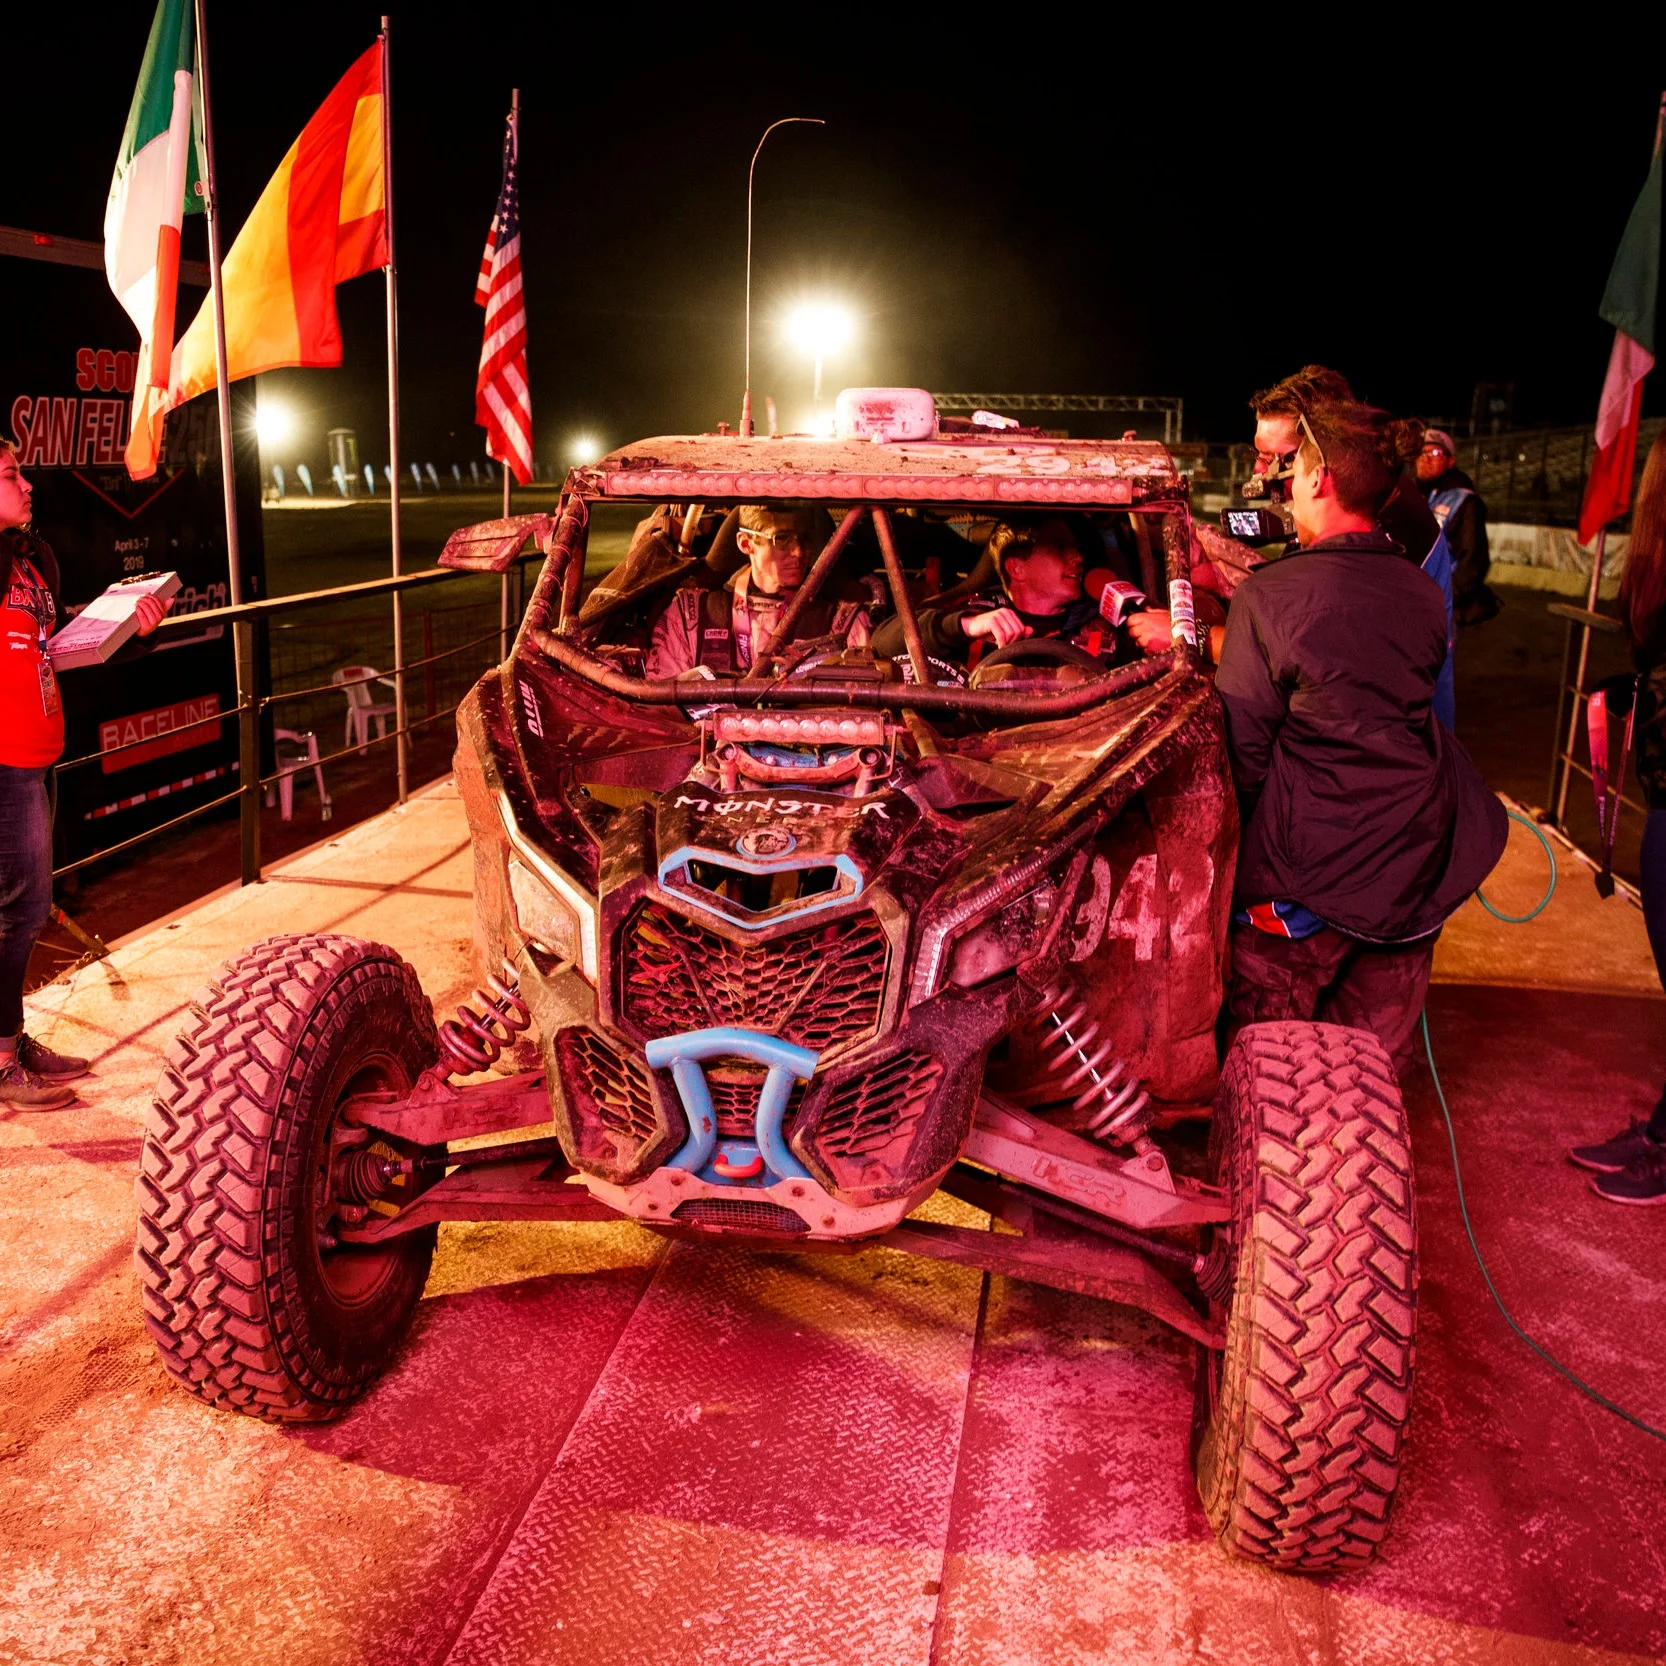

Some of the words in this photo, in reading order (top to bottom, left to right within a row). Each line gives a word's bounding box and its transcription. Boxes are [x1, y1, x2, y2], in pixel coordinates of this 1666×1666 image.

[76, 348, 138, 391] SCO
[11, 395, 77, 466] SAN
[114, 539, 133, 553] April
[123, 555, 145, 571] 2019
